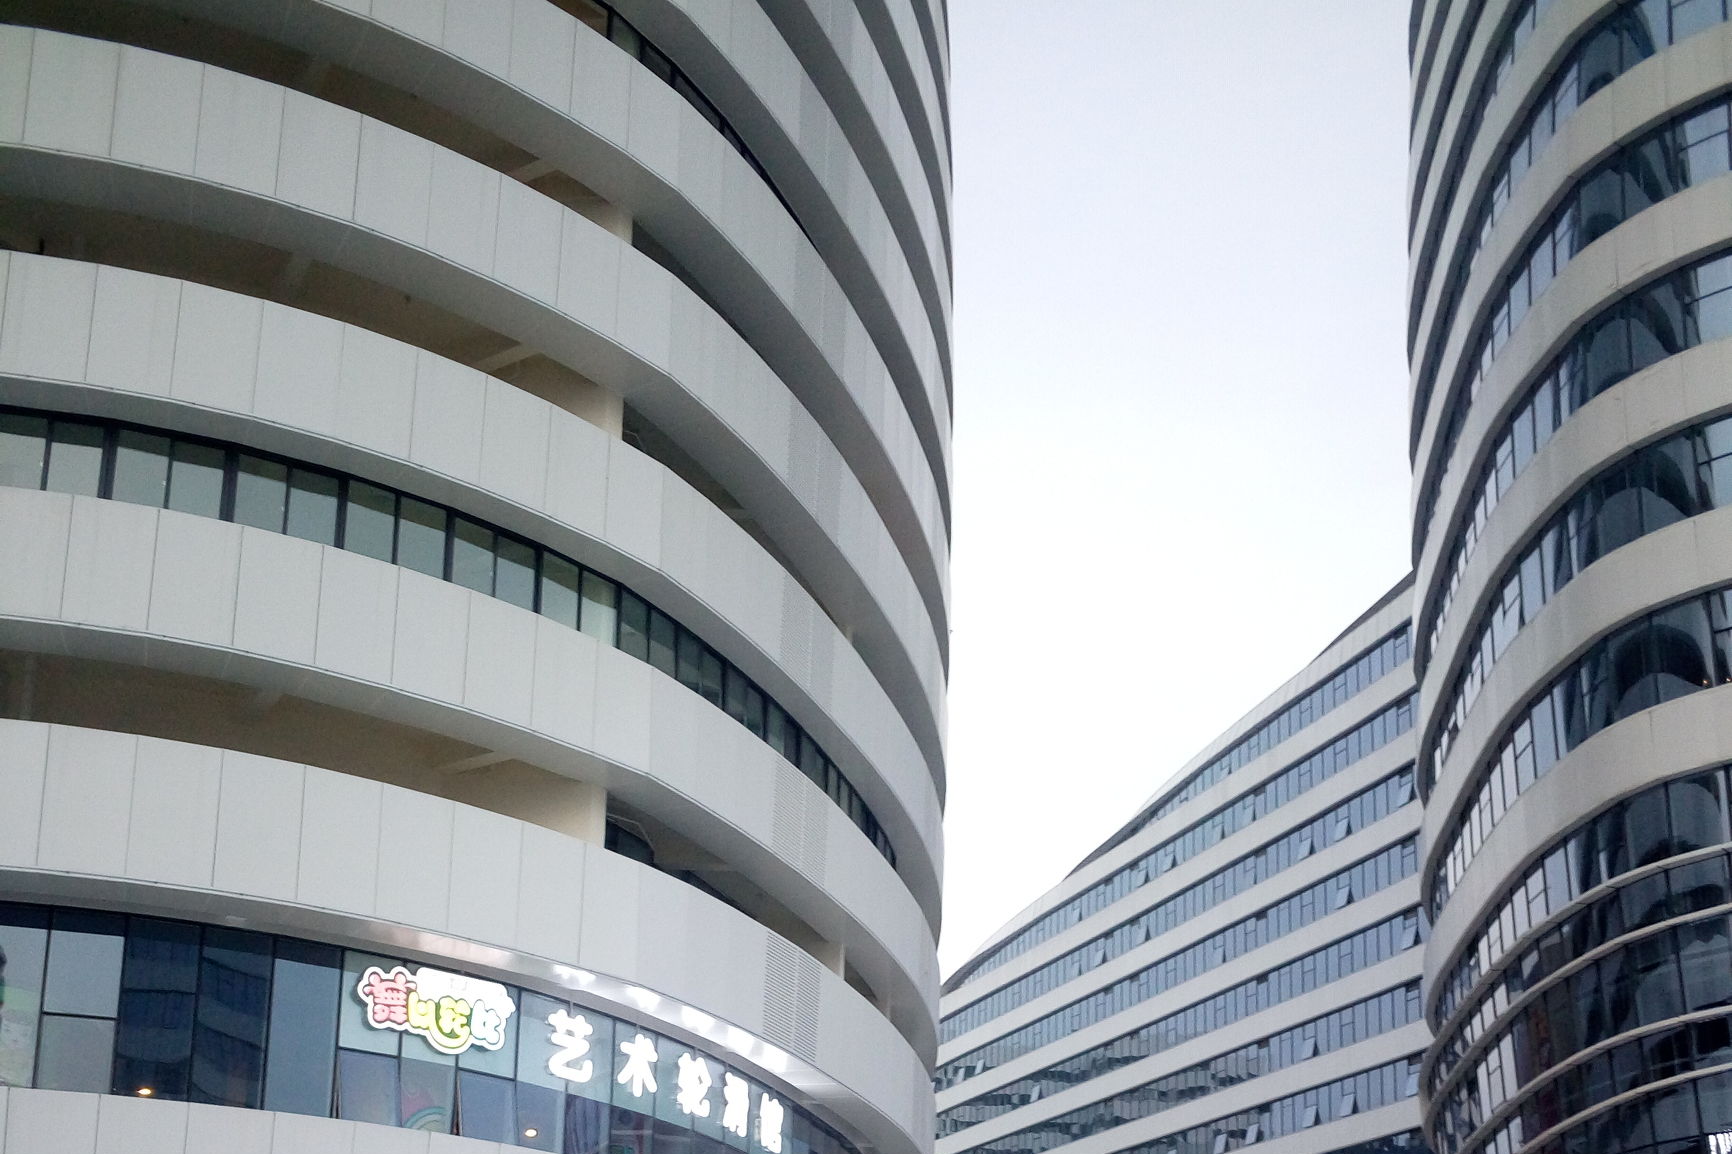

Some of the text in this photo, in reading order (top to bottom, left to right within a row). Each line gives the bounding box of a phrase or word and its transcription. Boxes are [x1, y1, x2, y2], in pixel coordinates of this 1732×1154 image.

[547, 1009, 785, 1154] 艺术轮滑馆
